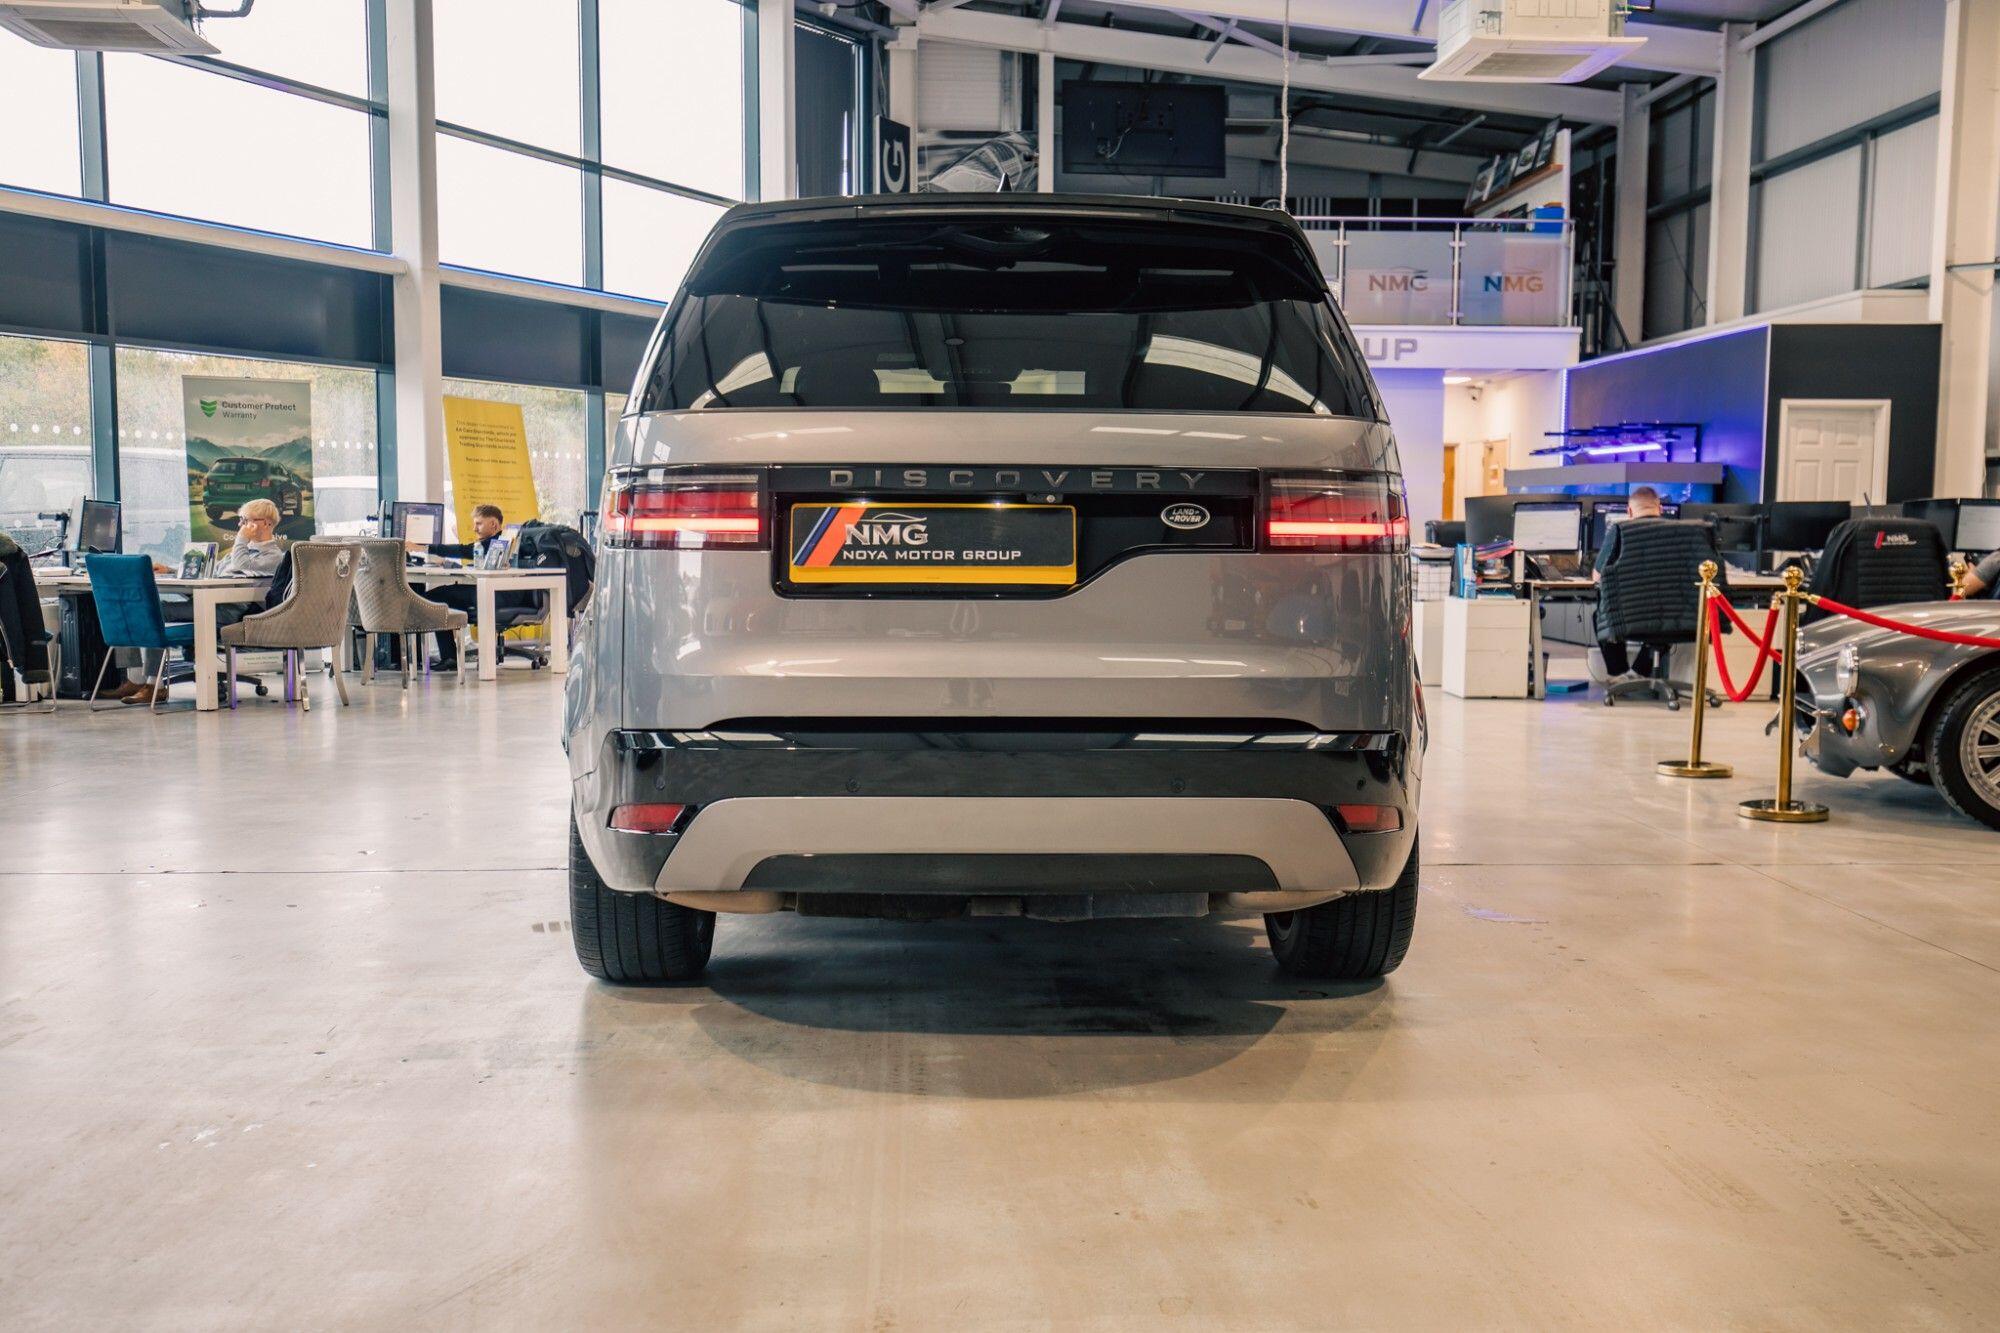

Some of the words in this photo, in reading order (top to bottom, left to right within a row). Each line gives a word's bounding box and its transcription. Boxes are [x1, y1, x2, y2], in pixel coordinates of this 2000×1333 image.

[1369, 275, 1428, 292] NMG
[1484, 275, 1544, 292] NMG
[222, 400, 263, 410] Customer
[265, 402, 296, 411] Protect
[222, 411, 257, 420] Warranty
[829, 469, 1205, 490] DISCOVERY
[844, 523, 929, 546] NMG
[843, 550, 888, 560] NOYA
[895, 550, 955, 560] MOTOR
[962, 550, 1022, 560] GROUP
